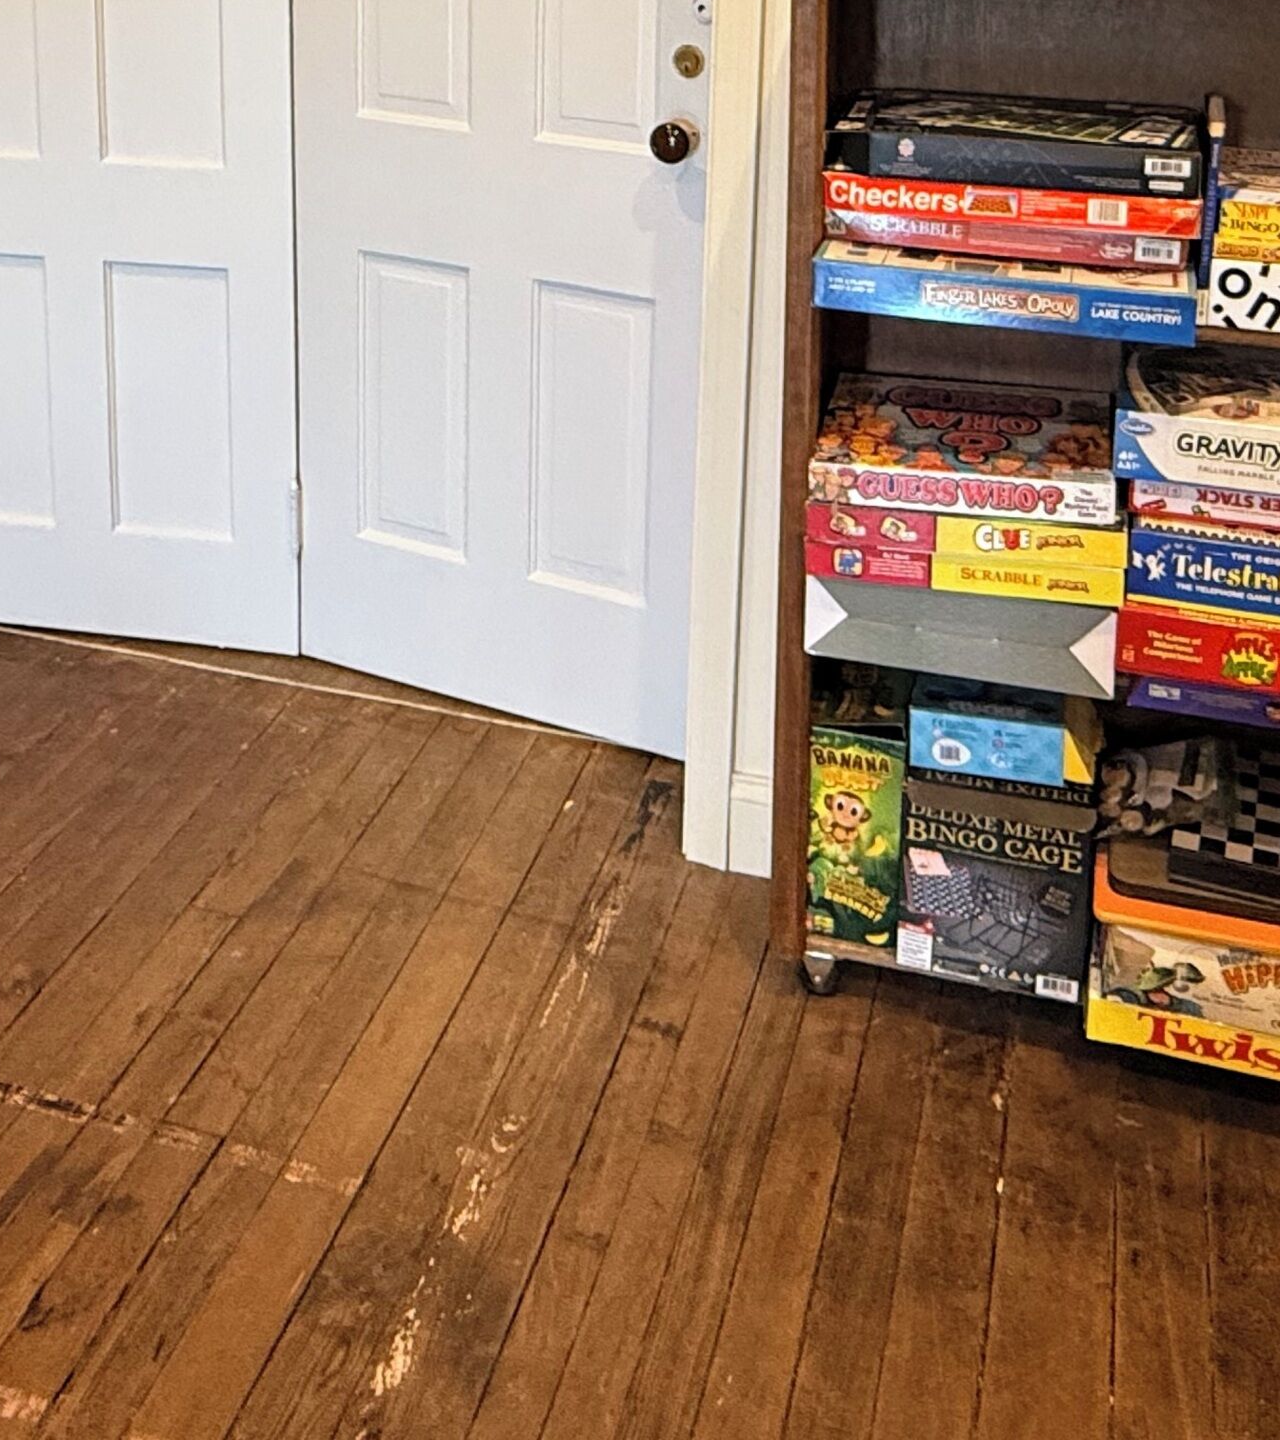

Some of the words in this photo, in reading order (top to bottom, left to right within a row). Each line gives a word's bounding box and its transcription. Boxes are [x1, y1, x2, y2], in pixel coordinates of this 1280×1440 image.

[829, 180, 959, 212] Checkers
[869, 216, 963, 239] SCRABBLE
[1230, 219, 1280, 232] BINGO
[923, 282, 976, 305] FINGER
[978, 289, 1018, 309] LAKES
[1090, 306, 1119, 320] LAKE
[1122, 310, 1182, 326] COUNTRY!
[902, 407, 1042, 436] WHO
[1238, 470, 1274, 481] MARBLE
[857, 471, 959, 506] GUESS
[959, 478, 1064, 515] WHO?
[1195, 488, 1254, 510] STACK
[973, 523, 1031, 552] CLUE
[1231, 552, 1252, 562] THE
[960, 567, 1042, 587] SCRABBLE
[1175, 582, 1193, 592] THE
[1195, 585, 1245, 599] TELEPHONE
[1246, 592, 1272, 603] GAME
[1147, 630, 1163, 640] The
[1164, 632, 1190, 644] Game
[811, 747, 890, 773] BANANA
[909, 803, 998, 833] DELUXE
[1003, 819, 1081, 848] METAL
[906, 816, 998, 853] BINGO
[1004, 839, 1083, 875] CAGE
